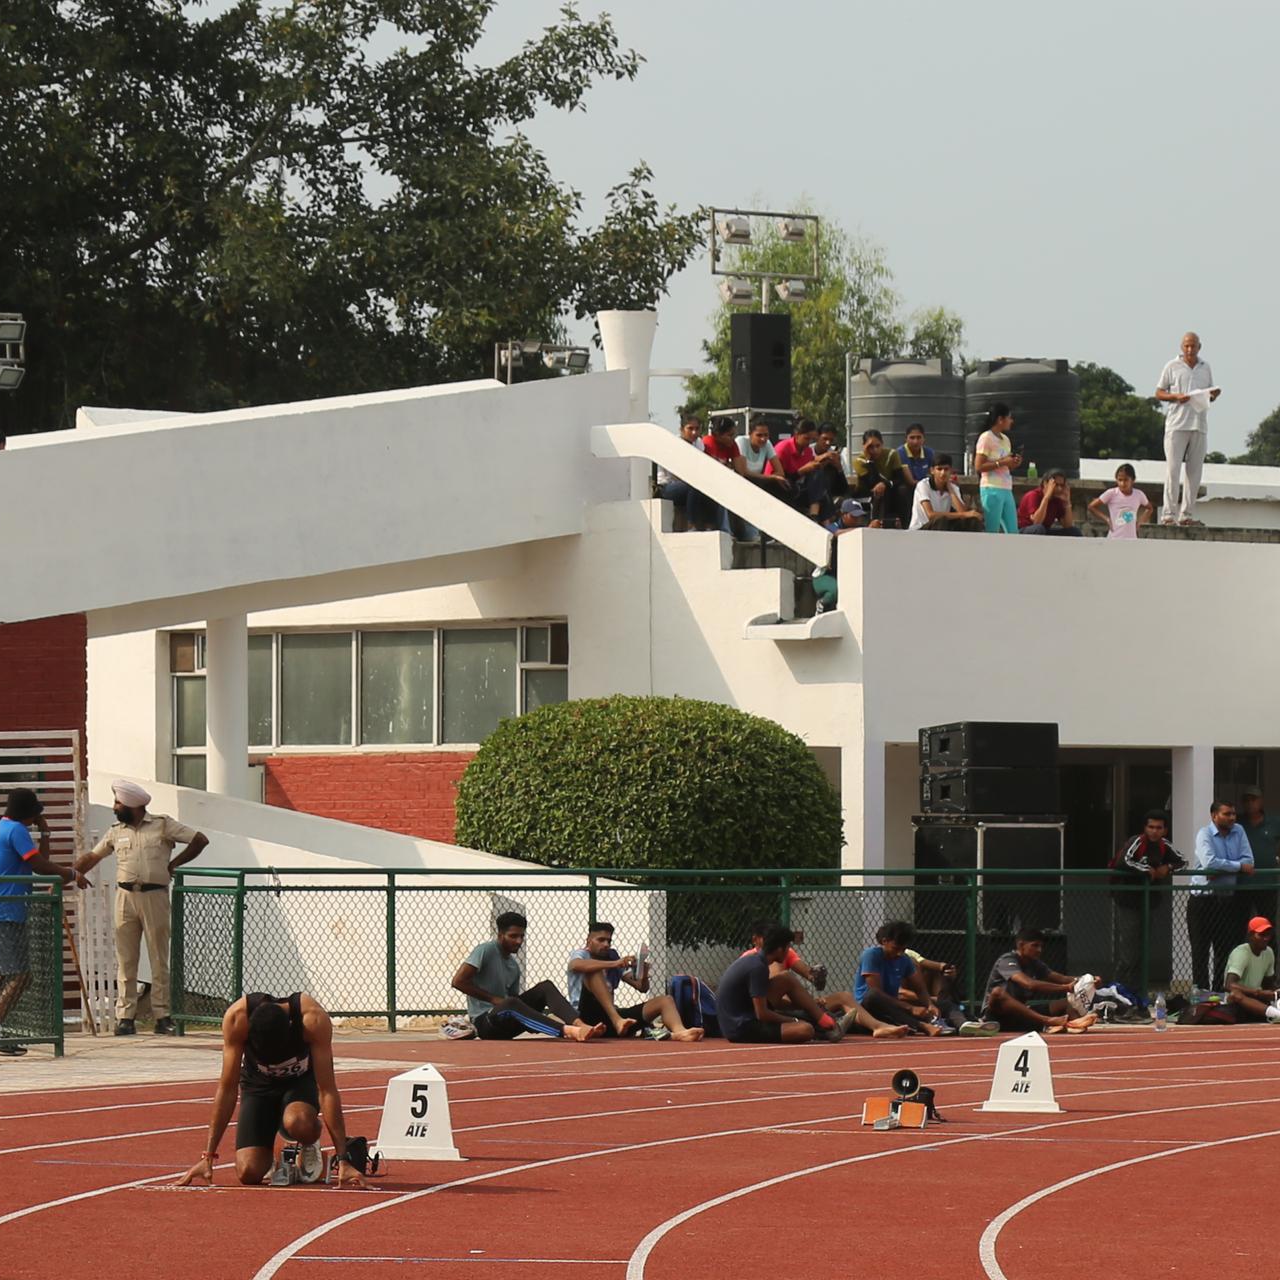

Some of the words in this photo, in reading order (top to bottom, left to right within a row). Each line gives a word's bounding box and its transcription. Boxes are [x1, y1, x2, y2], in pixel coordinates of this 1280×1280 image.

[1014, 1049, 1029, 1077] 4
[1011, 1081, 1031, 1093] ATE
[410, 1084, 428, 1119] 5
[405, 1122, 429, 1137] ATE
